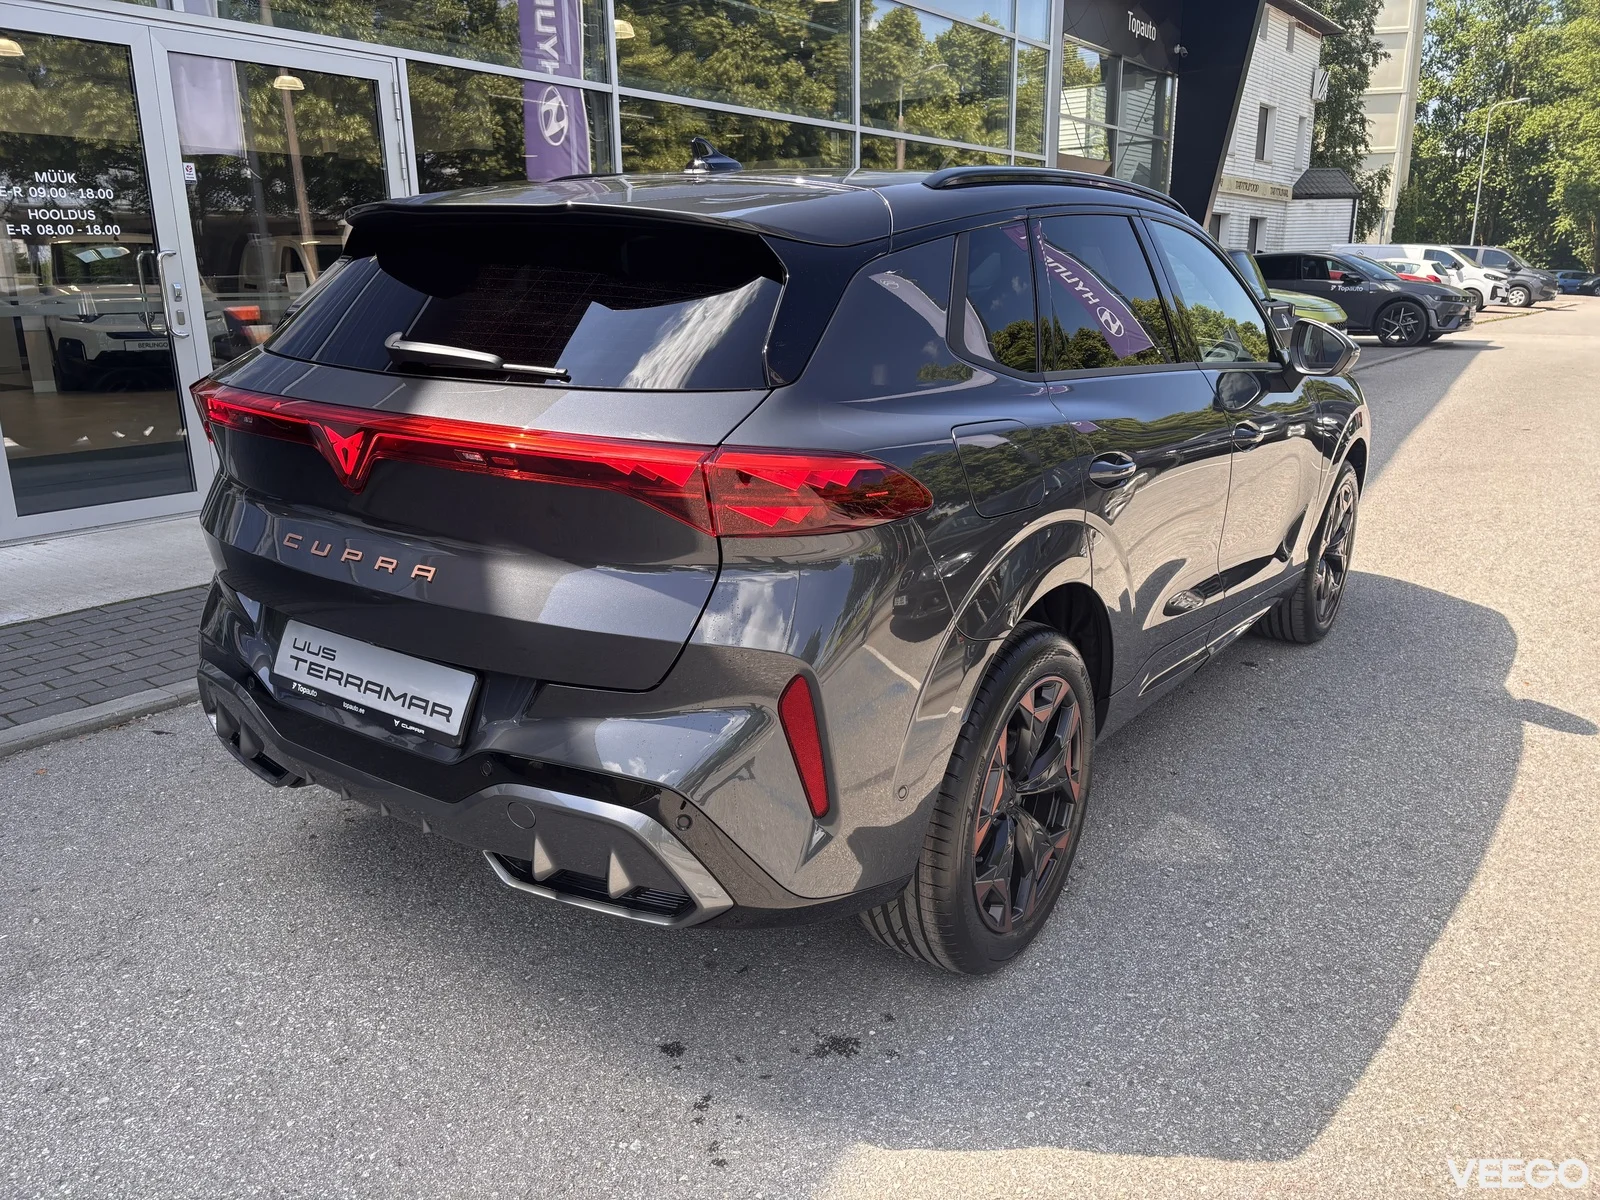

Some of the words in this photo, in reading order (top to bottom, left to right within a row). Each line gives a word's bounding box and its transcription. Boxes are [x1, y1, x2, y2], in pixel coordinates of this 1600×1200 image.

[1127, 10, 1157, 41] Topauto
[34, 169, 77, 184] MÜÜK
[0, 186, 23, 197] E-R
[28, 187, 67, 198] 09.00
[78, 188, 114, 199] 18.00
[27, 209, 96, 220] HOOLDUS
[6, 224, 32, 236] E-R
[36, 224, 74, 235] 08.00
[85, 224, 121, 236] 18.00
[1337, 284, 1364, 293] Topauto
[282, 532, 438, 584] CUPRA
[292, 637, 337, 662] UUS
[289, 654, 454, 724] TERRAMAR
[297, 683, 318, 698] Topauto
[342, 701, 366, 715] topauto.ee
[400, 723, 425, 735] CUPRA
